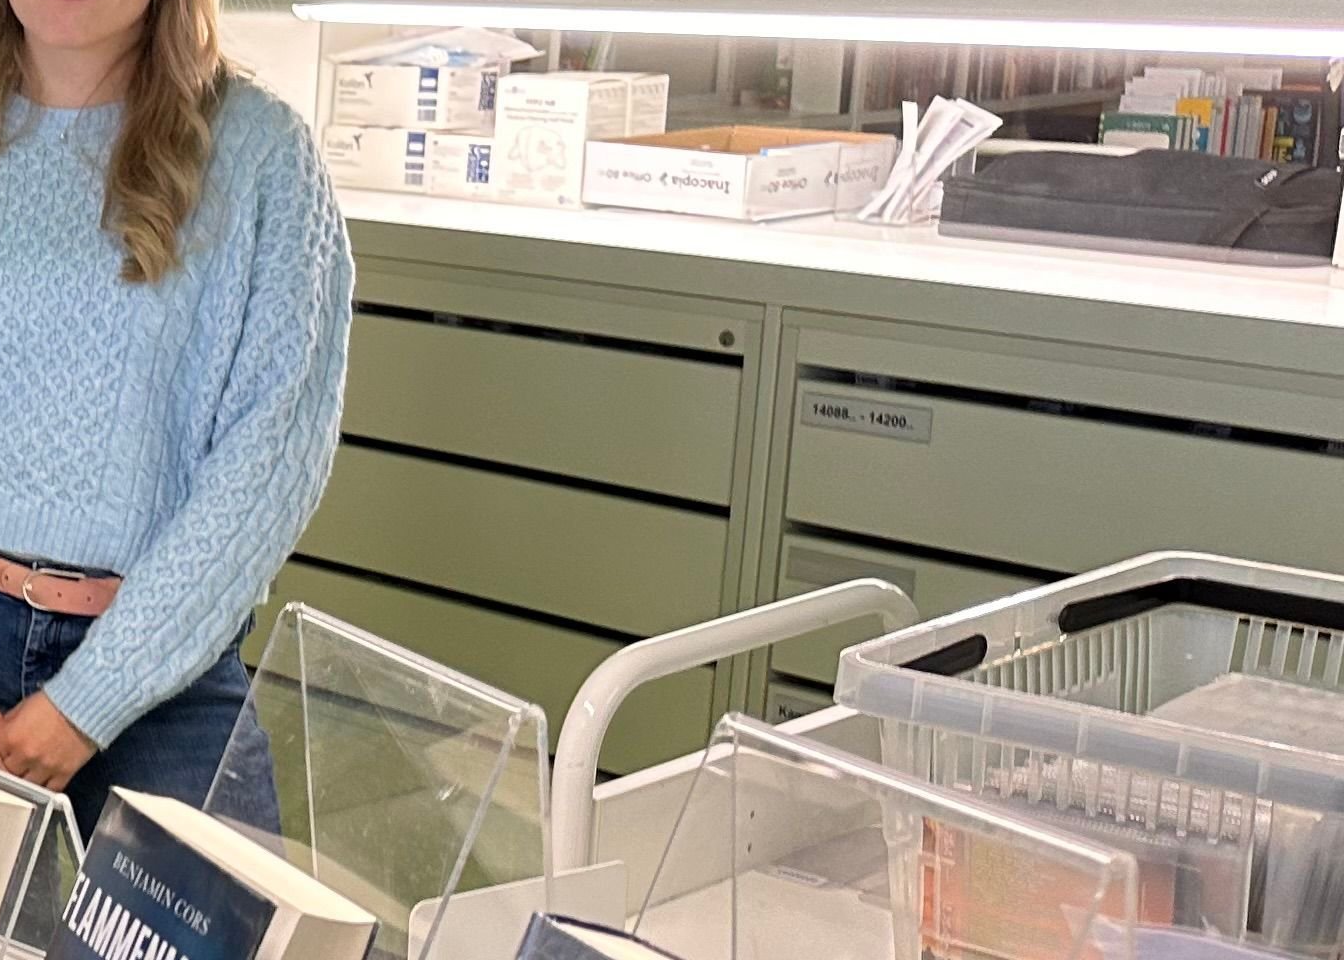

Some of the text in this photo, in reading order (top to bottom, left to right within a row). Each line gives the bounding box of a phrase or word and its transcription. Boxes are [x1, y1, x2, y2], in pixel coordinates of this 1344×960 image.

[671, 173, 730, 195] Inacopia
[112, 851, 211, 937] BENJAMIN CORS
